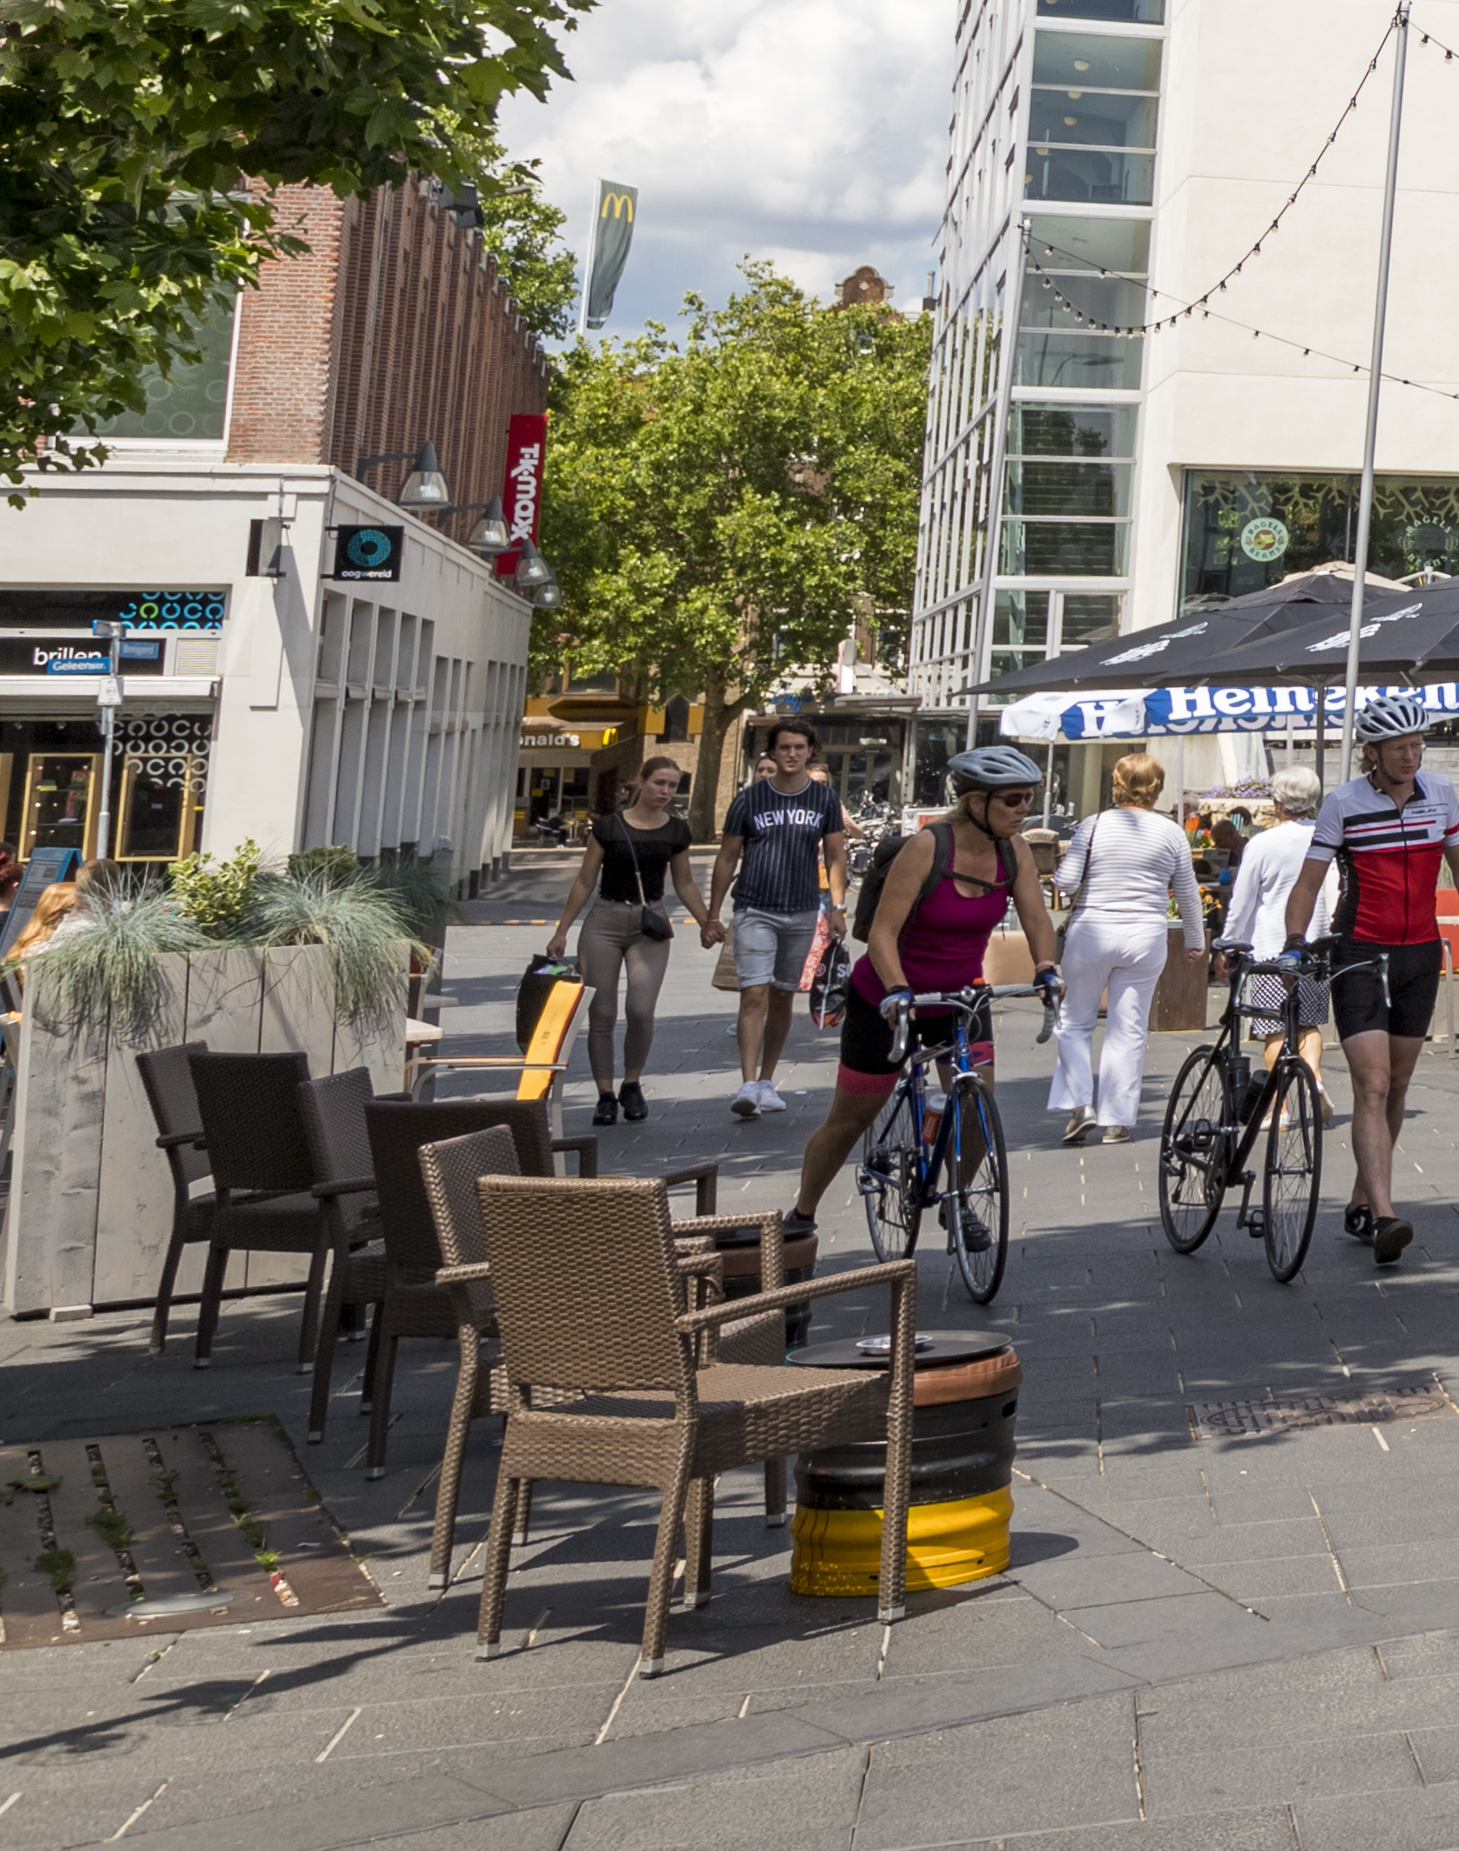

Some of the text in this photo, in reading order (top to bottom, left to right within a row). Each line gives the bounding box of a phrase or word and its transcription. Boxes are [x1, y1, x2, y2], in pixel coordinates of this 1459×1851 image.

[1406, 516, 1452, 537] BAGELS
[341, 569, 393, 580] oogwereld
[33, 647, 102, 666] brillen
[754, 808, 824, 830] NEW YORK
